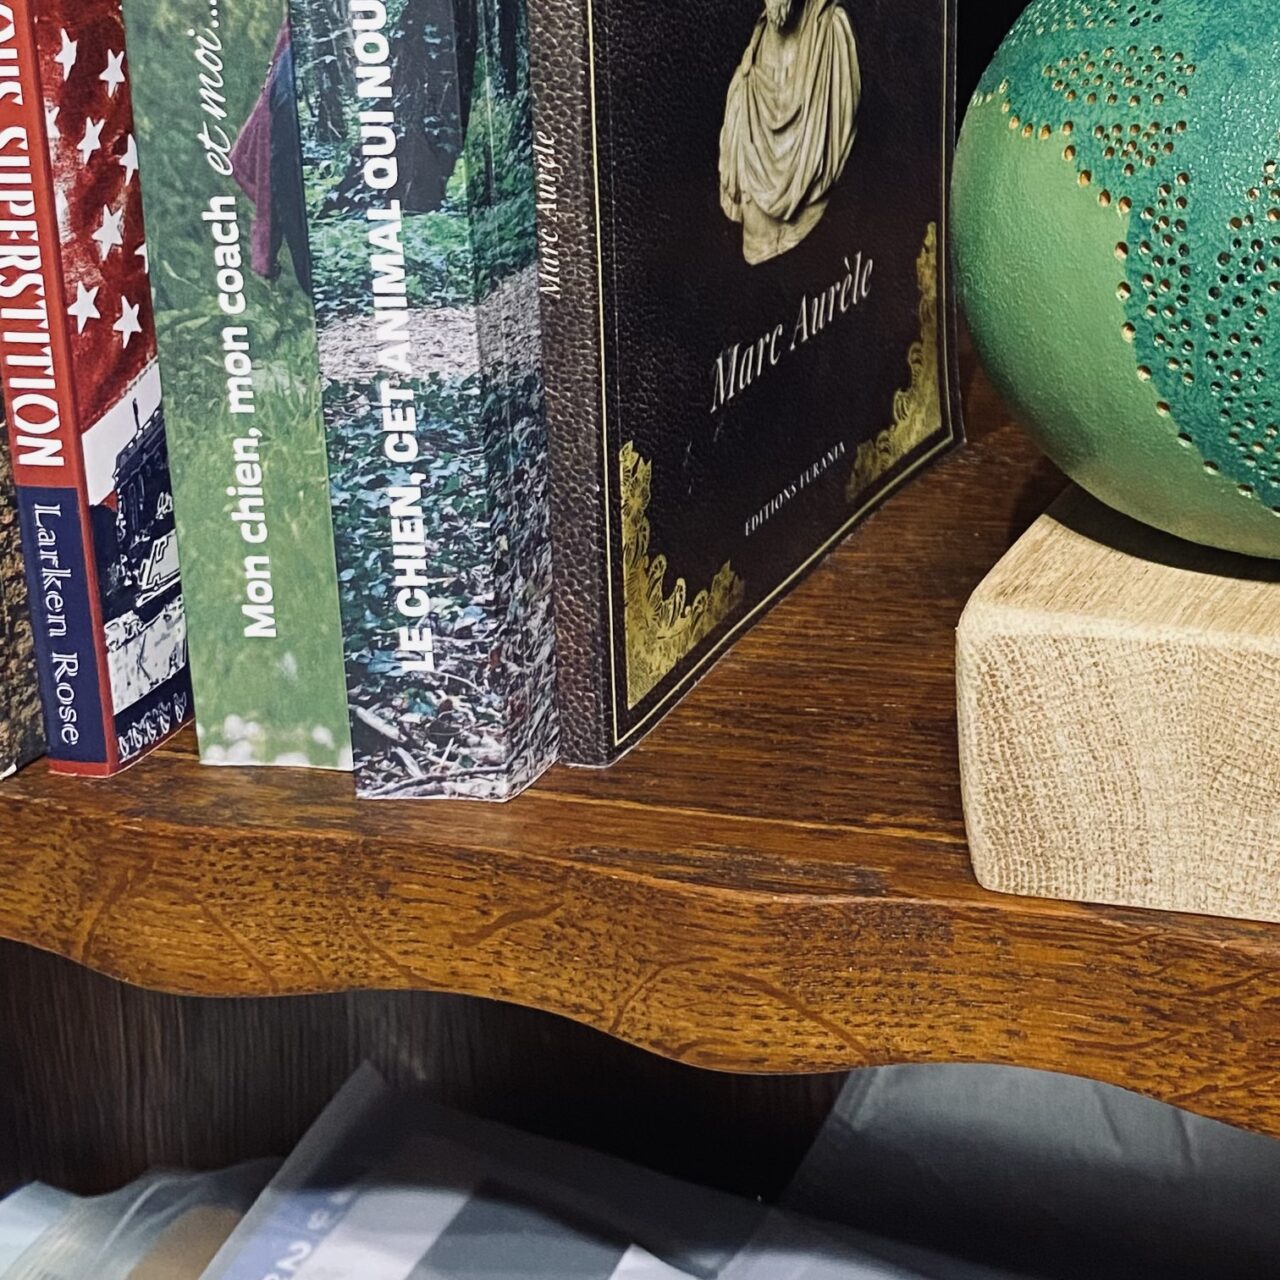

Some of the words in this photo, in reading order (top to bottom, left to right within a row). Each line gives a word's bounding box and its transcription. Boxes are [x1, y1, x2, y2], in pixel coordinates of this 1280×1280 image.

[197, 120, 234, 176] et
[360, 111, 400, 191] QUI
[202, 195, 247, 315] coach
[366, 199, 412, 375] ANIMAL
[536, 228, 562, 301] Marc
[221, 326, 256, 415] mon
[709, 323, 784, 414] Marc
[790, 251, 874, 352] Aurèle
[382, 380, 420, 464] CET
[226, 426, 269, 545] chien,
[34, 503, 72, 638] Larken
[388, 472, 431, 617] CHIEN,
[242, 555, 277, 639] Mon
[400, 628, 436, 673] LE
[51, 651, 80, 746] Rose
